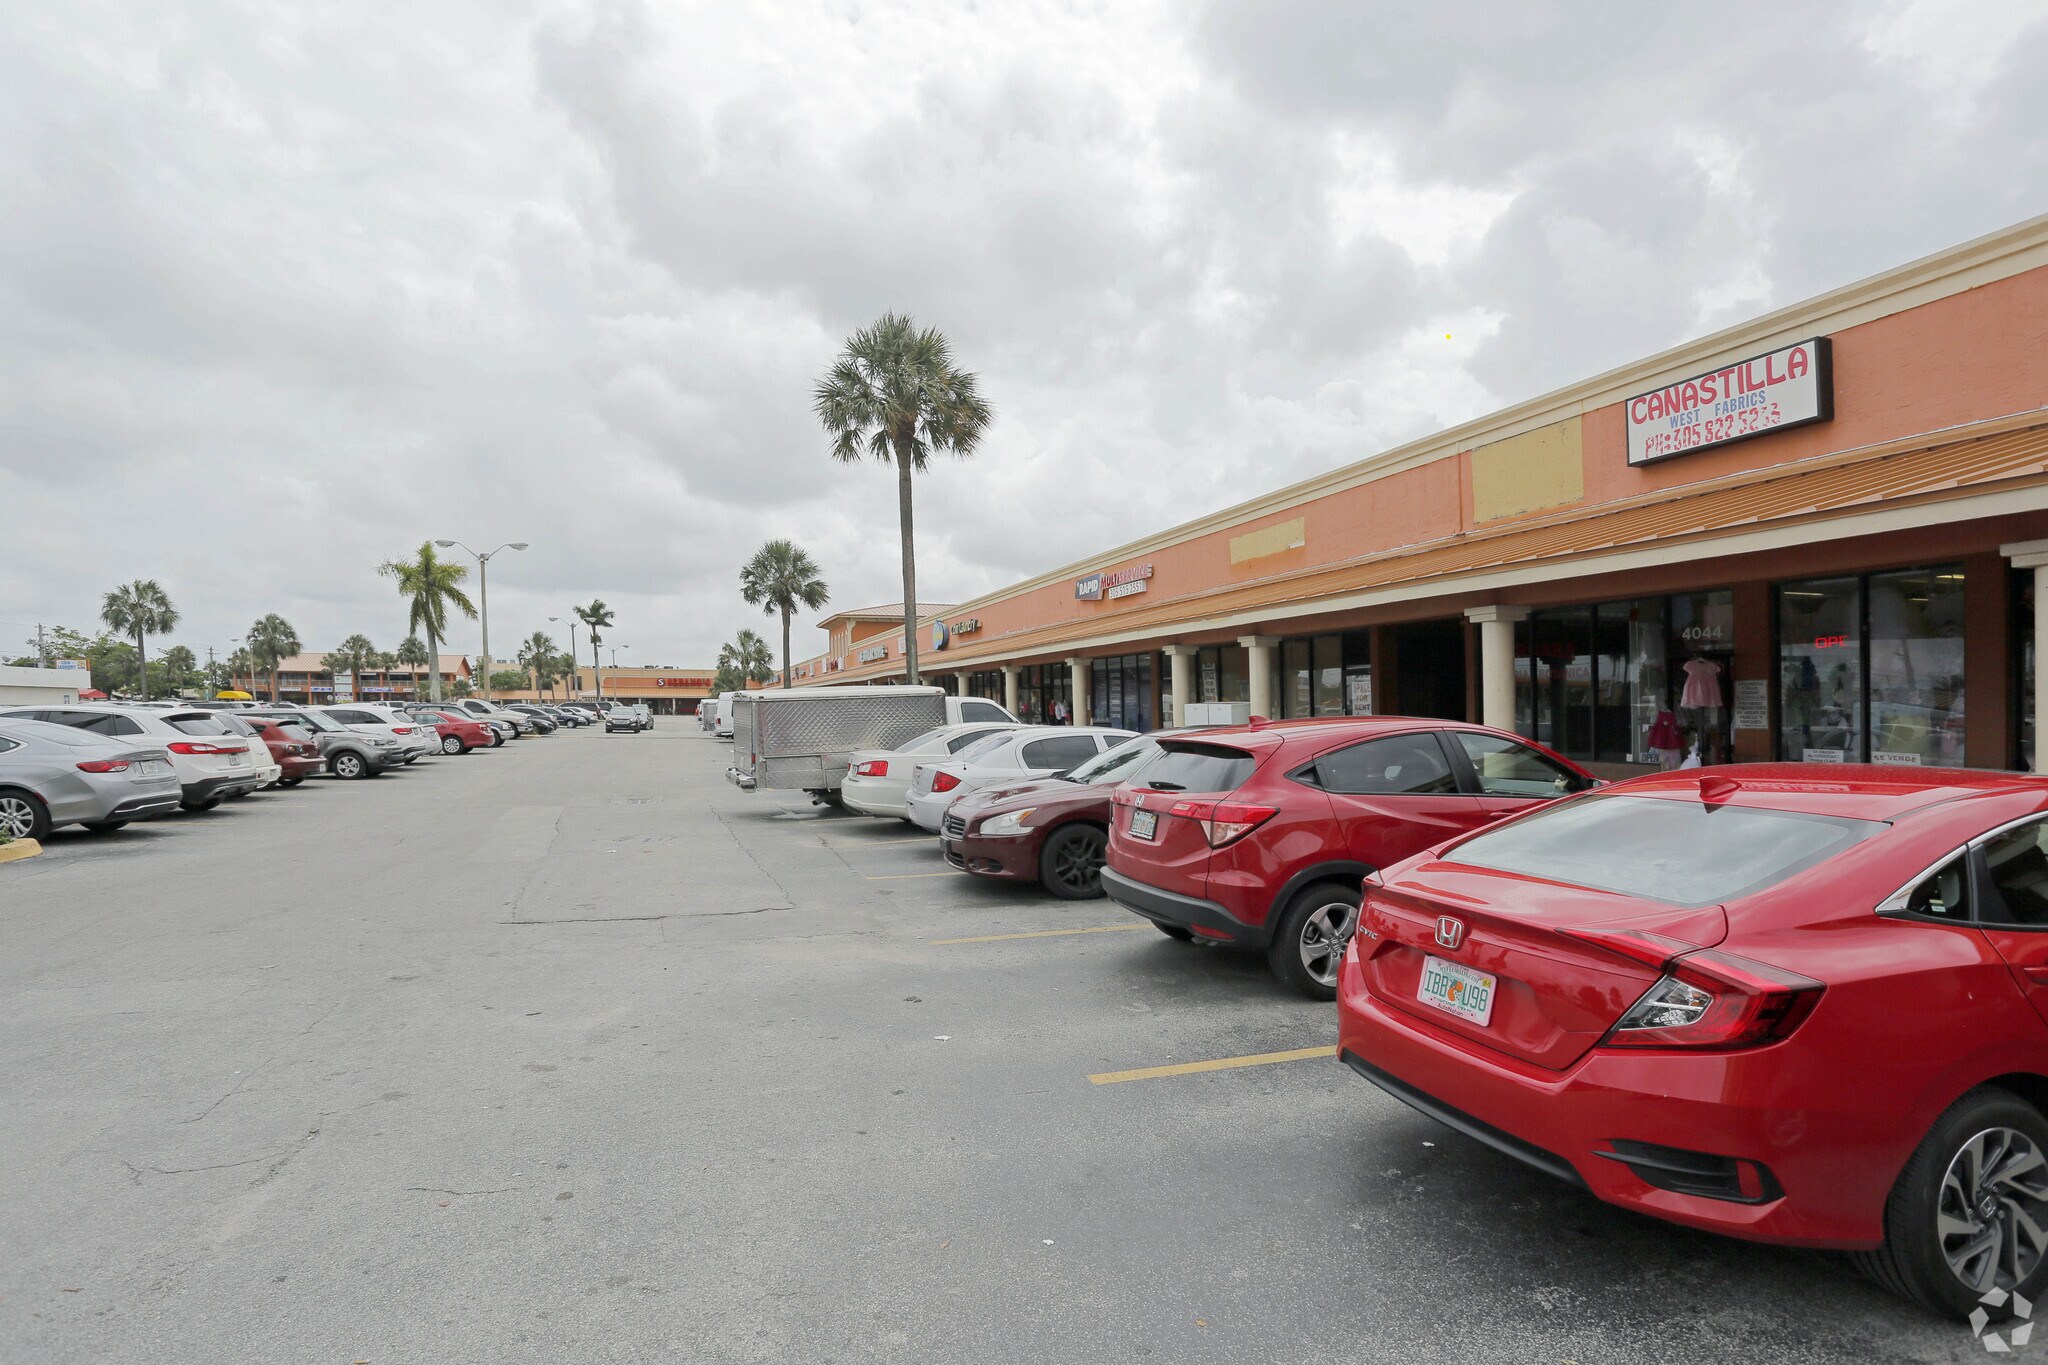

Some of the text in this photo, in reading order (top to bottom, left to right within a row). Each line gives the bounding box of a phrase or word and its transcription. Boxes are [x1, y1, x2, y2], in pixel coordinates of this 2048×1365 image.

[1631, 347, 1808, 425] CANASTILLA
[1669, 390, 1766, 429] WEST FABRICS
[1674, 423, 1701, 451] 305
[1705, 414, 1734, 443] 822
[1079, 579, 1099, 596] RAPID
[1682, 626, 1722, 640] 4044
[1355, 703, 1370, 711] RENT
[1888, 755, 1917, 763] VENDE
[1360, 925, 1378, 940] CIVIC
[1425, 970, 1489, 1012] IBB U98
[1437, 1003, 1464, 1017] AutoNation
